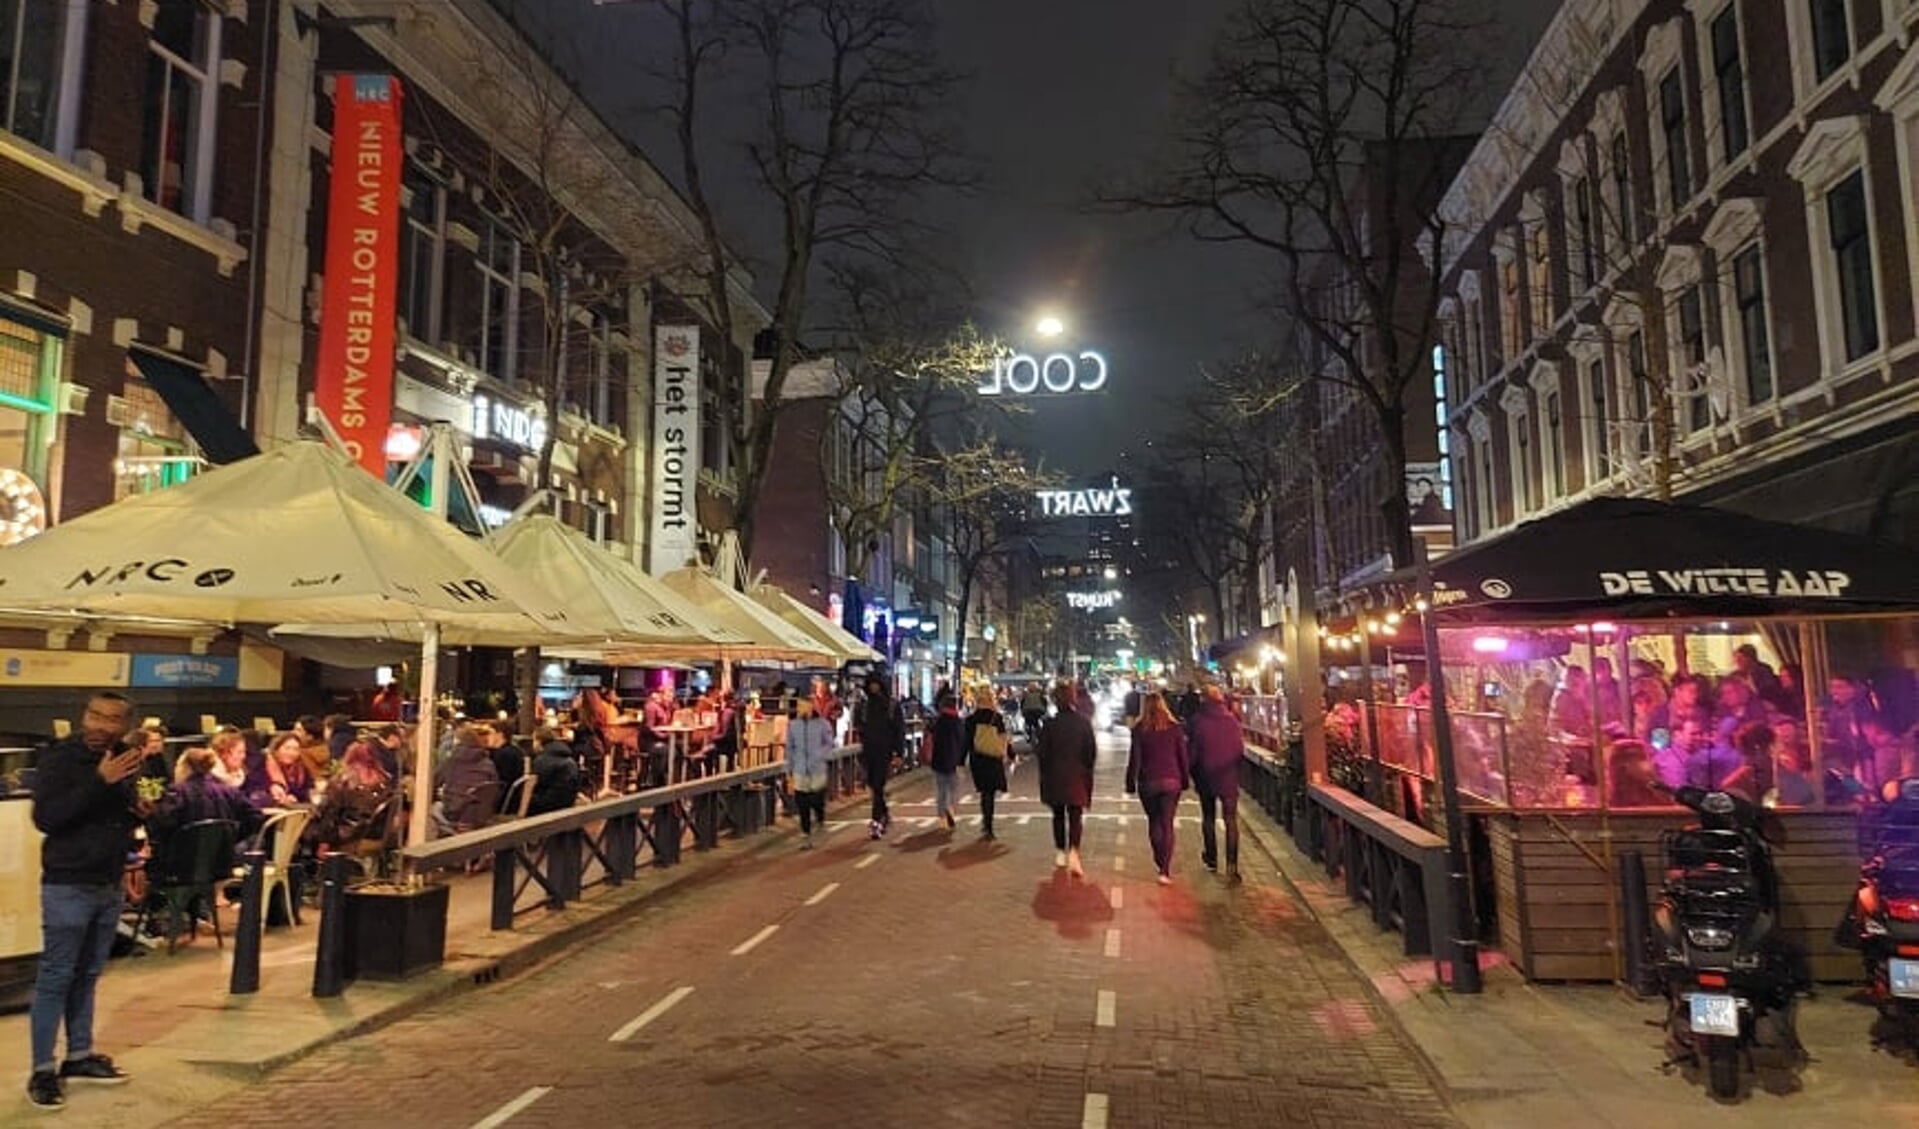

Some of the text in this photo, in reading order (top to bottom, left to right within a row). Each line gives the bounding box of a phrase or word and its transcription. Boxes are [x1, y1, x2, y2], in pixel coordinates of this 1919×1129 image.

[357, 121, 382, 216] NIEUW
[341, 229, 378, 428] ROTTERDAMS
[665, 366, 691, 414] het
[663, 427, 688, 529] stormt
[64, 558, 188, 590] NRC
[1599, 570, 1654, 595] DE
[1775, 569, 1851, 596] AAP
